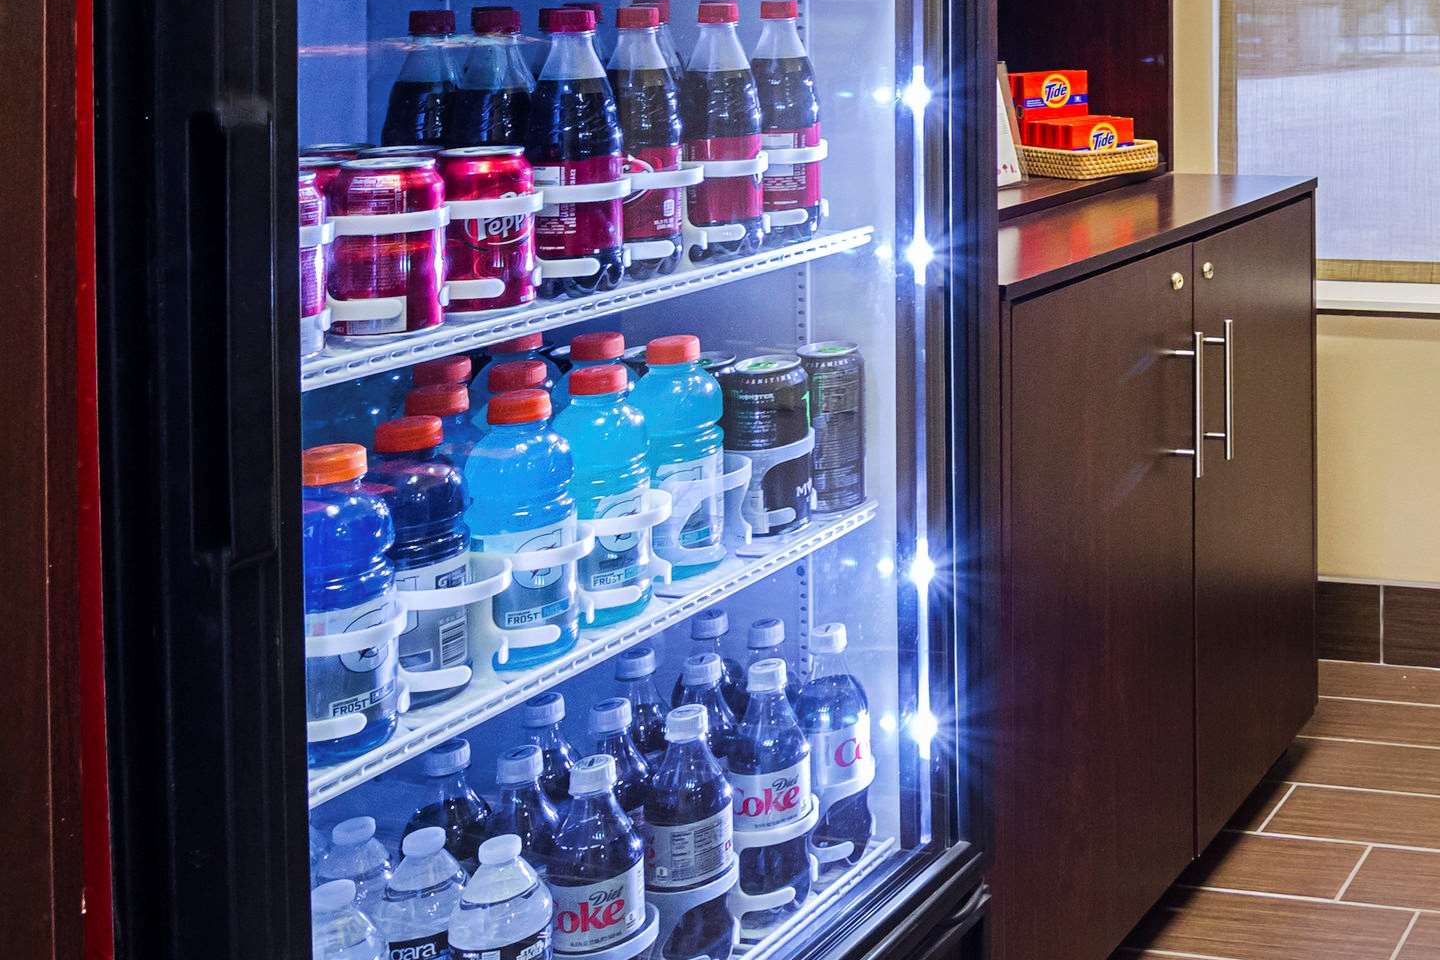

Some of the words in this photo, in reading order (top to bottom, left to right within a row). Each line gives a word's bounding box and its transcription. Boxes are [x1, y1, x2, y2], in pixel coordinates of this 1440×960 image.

[1045, 83, 1068, 102] Tide
[1092, 132, 1115, 150] Tide
[507, 613, 540, 625] FROST
[332, 700, 367, 717] FROST
[555, 899, 625, 933] oke
